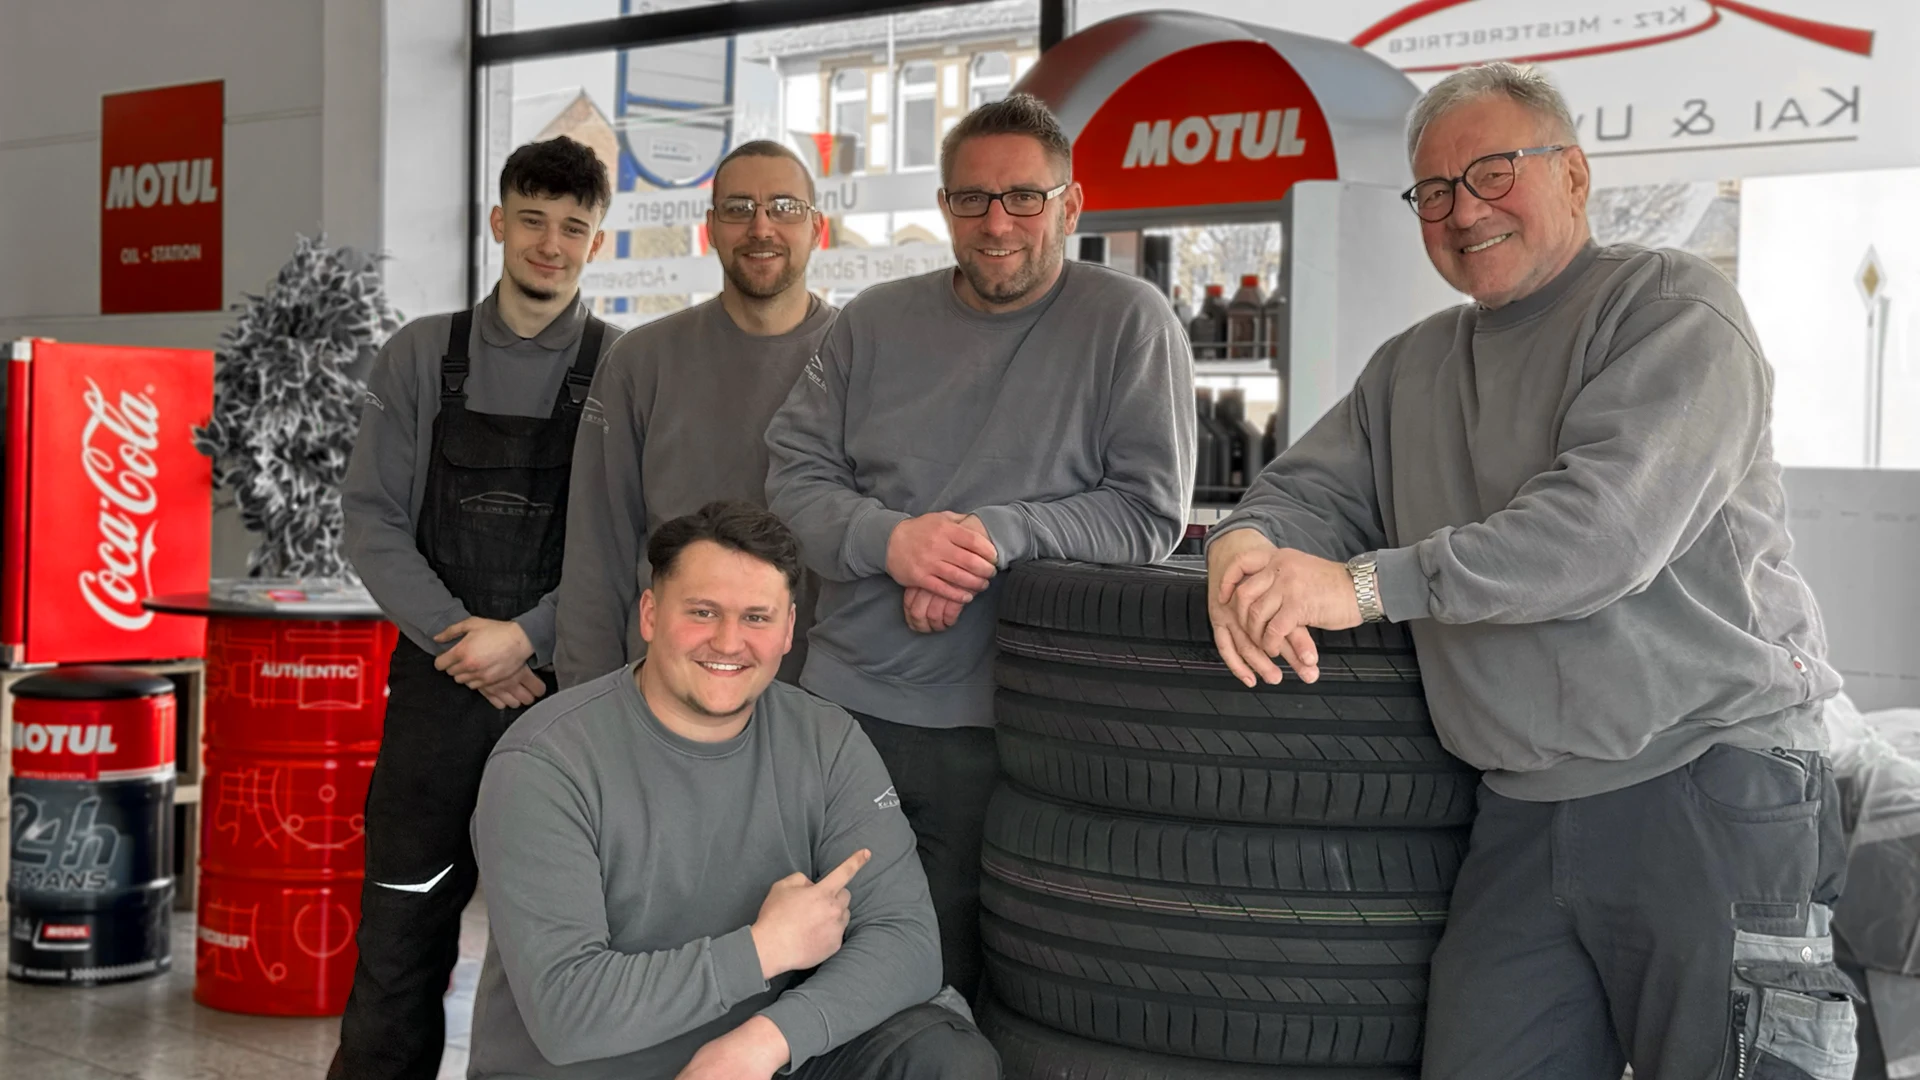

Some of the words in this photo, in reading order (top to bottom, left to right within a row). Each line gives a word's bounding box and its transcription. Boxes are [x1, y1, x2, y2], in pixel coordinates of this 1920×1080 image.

[1121, 107, 1307, 169] MOTUL
[104, 157, 218, 210] MOTUL
[120, 246, 141, 265] OIL
[150, 243, 203, 263] STATION
[259, 661, 361, 679] AUTHENTIC
[23, 869, 110, 892] MANS
